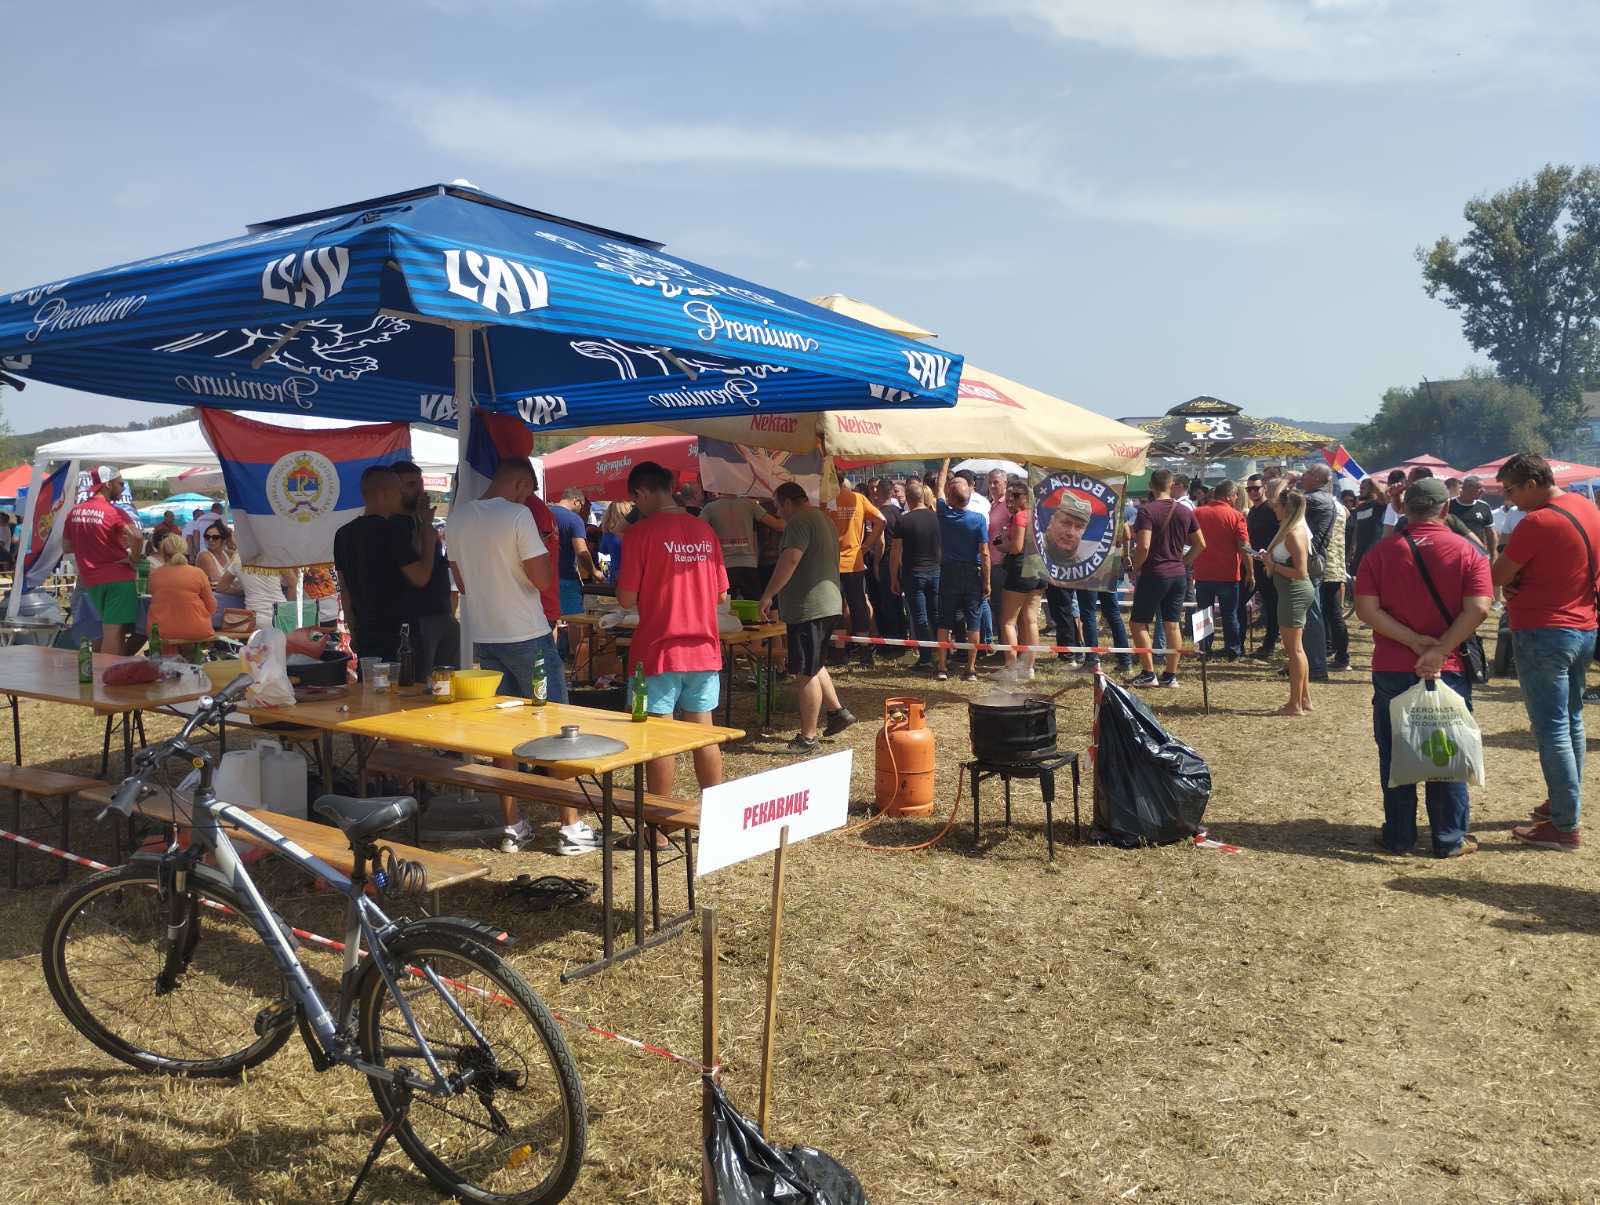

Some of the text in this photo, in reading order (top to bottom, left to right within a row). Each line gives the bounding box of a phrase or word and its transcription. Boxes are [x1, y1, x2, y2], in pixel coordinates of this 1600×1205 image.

[262, 246, 349, 309] LAV
[443, 249, 550, 314] LAV
[25, 292, 147, 341] Premium
[683, 301, 819, 352] Premium
[901, 350, 952, 390] LAV
[750, 413, 799, 433] Nektar
[836, 414, 882, 435] Nektar
[743, 789, 810, 830] РЕКАВИЦЕ
